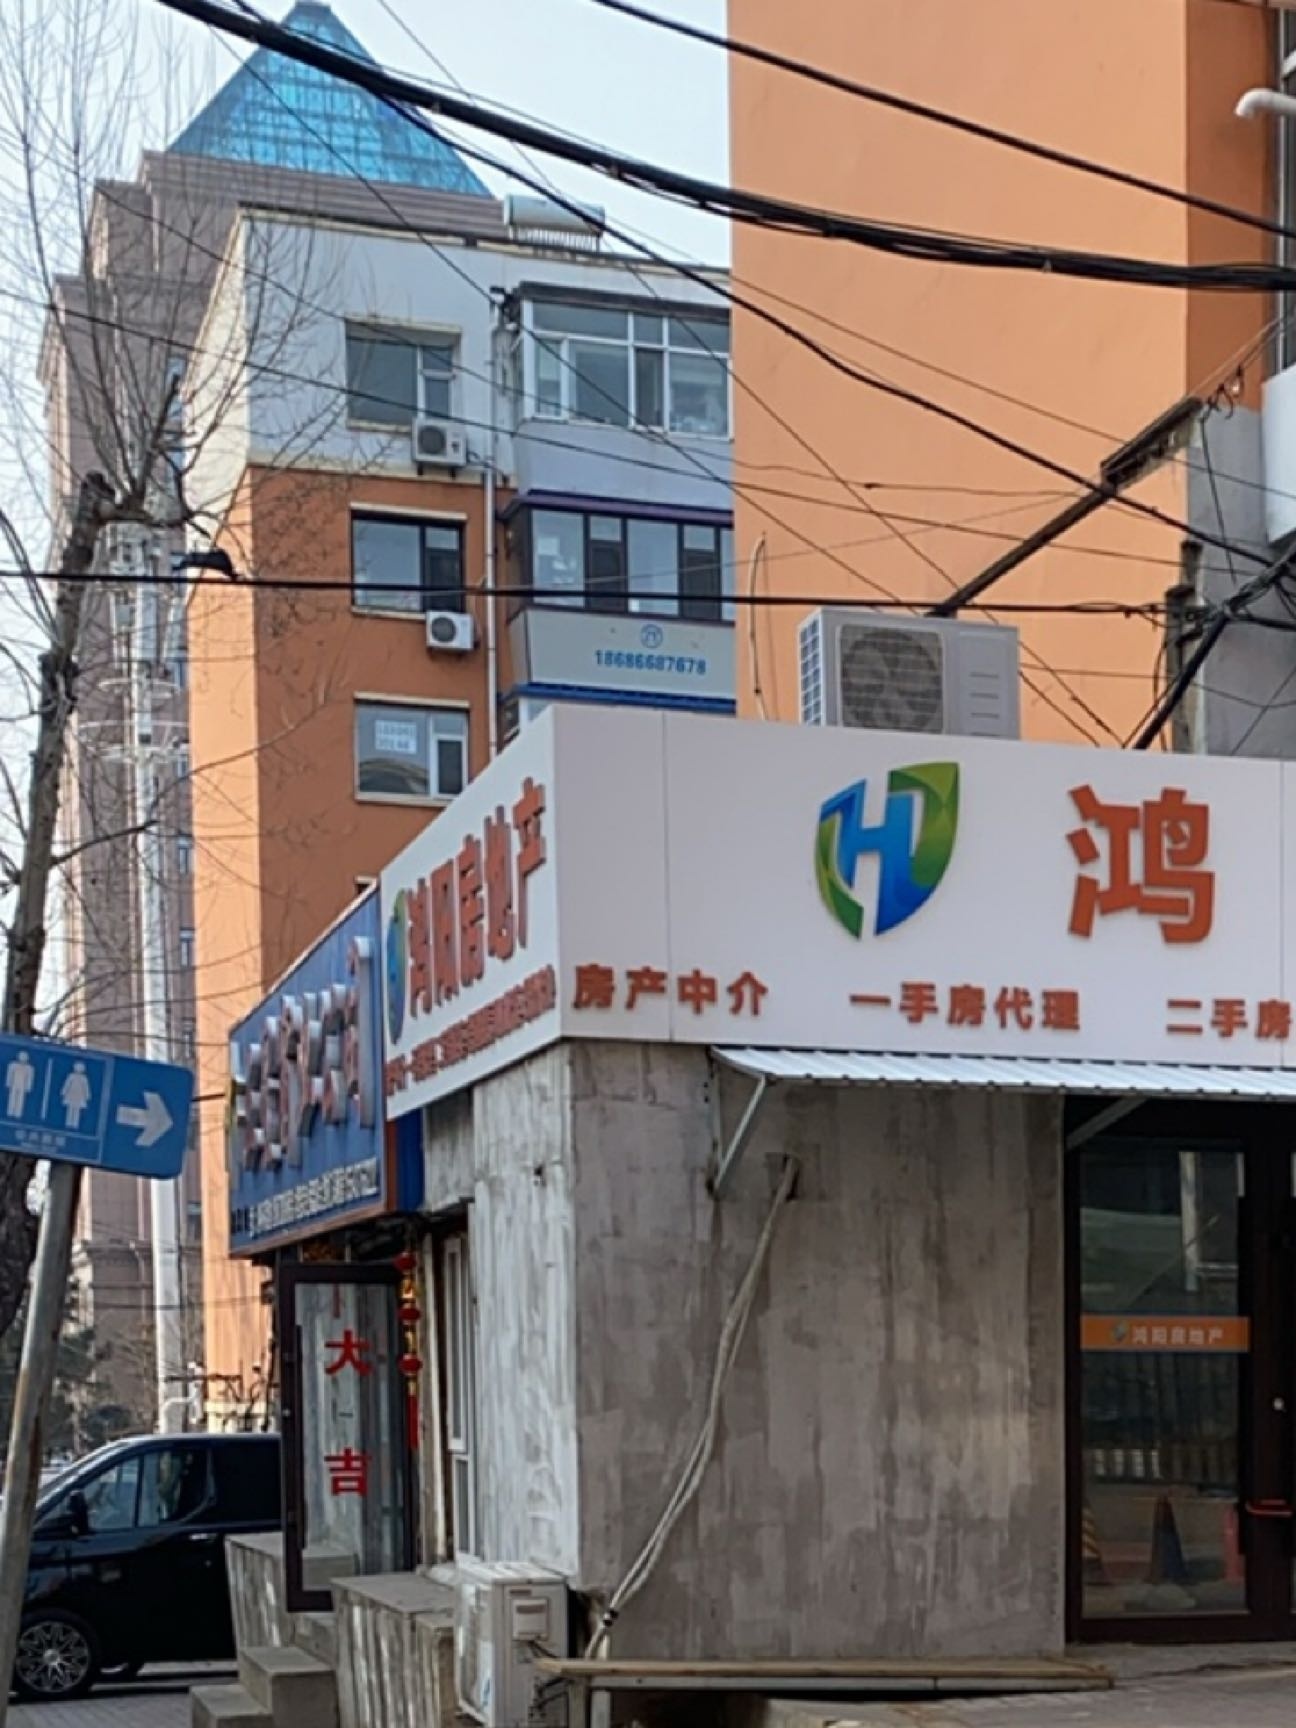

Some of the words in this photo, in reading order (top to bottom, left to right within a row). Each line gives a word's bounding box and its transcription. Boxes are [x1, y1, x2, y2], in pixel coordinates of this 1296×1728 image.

[573, 963, 768, 1016] 房产中介
[850, 982, 1080, 1031] 一手房代理
